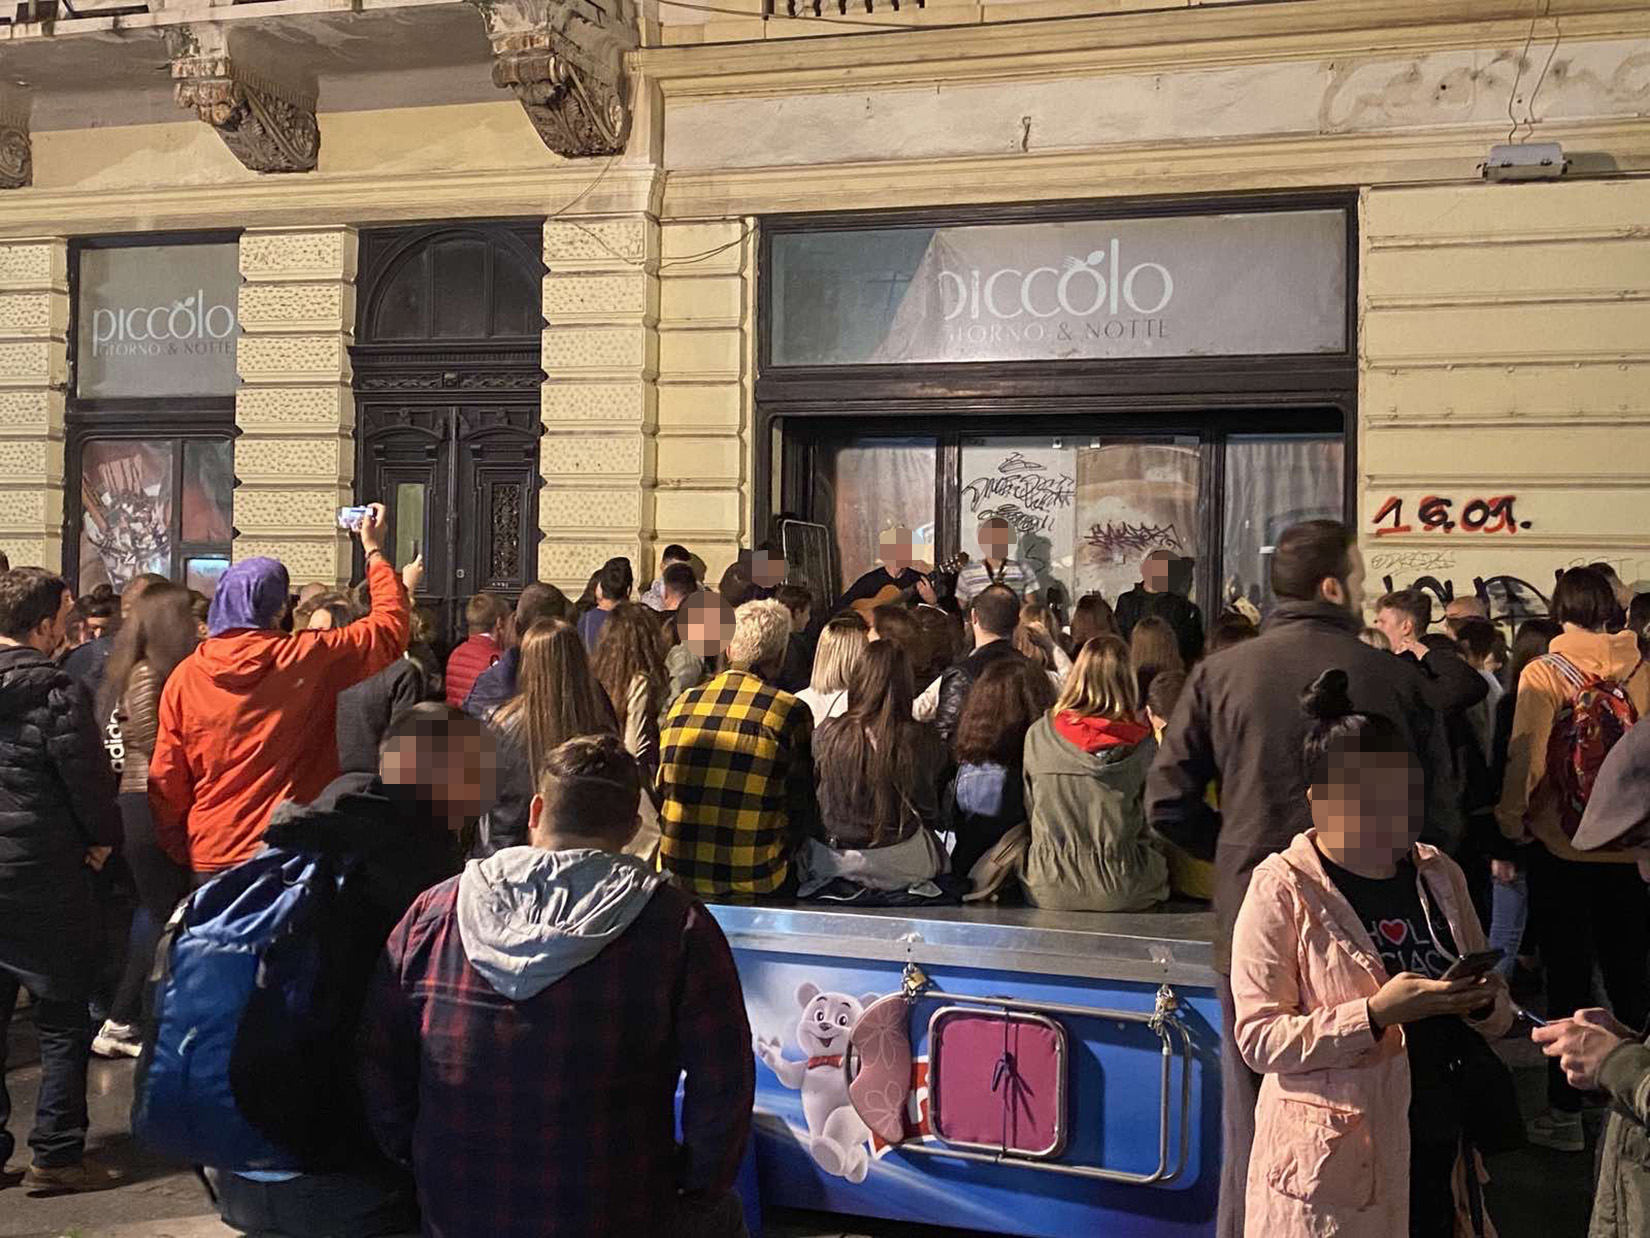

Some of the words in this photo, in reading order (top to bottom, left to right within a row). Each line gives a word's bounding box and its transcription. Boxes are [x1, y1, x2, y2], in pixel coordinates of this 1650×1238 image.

[92, 288, 235, 357] piccolo
[1057, 321, 1074, 341] &
[1085, 319, 1172, 339] NOTTE
[183, 340, 232, 356] NOTTE
[104, 700, 125, 773] adida
